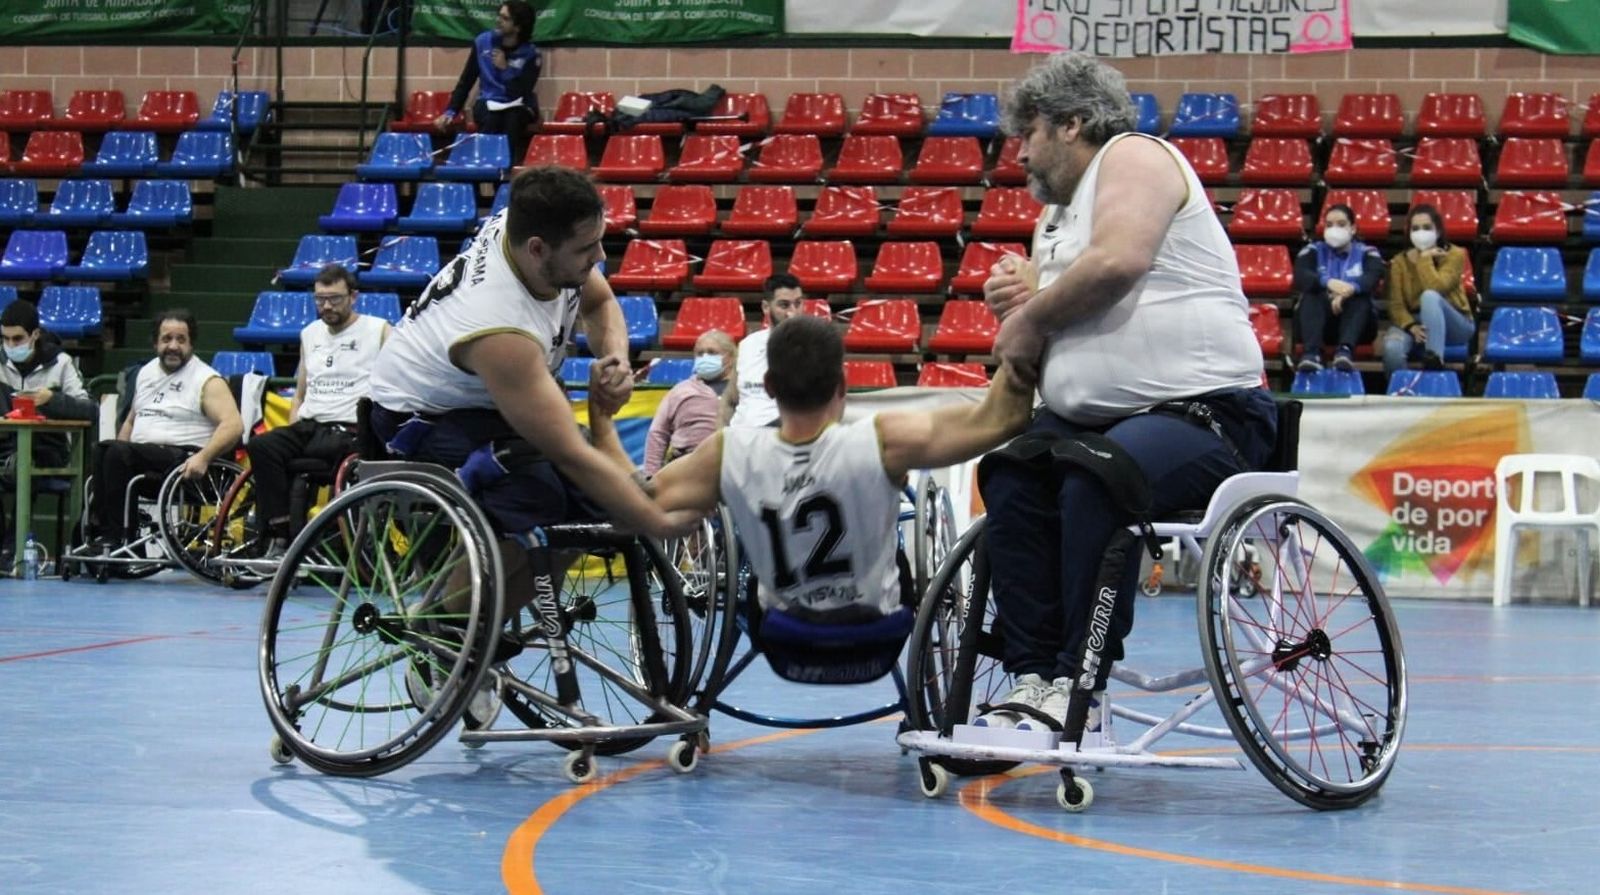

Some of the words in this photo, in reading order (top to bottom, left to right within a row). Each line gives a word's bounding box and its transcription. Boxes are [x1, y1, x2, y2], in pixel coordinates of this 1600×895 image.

[1070, 13, 1291, 57] DEPORTISTAS
[1392, 472, 1498, 502] Deport
[1391, 501, 1428, 525] de
[1437, 507, 1487, 531] por
[760, 491, 854, 592] 12
[1391, 530, 1452, 554] vida
